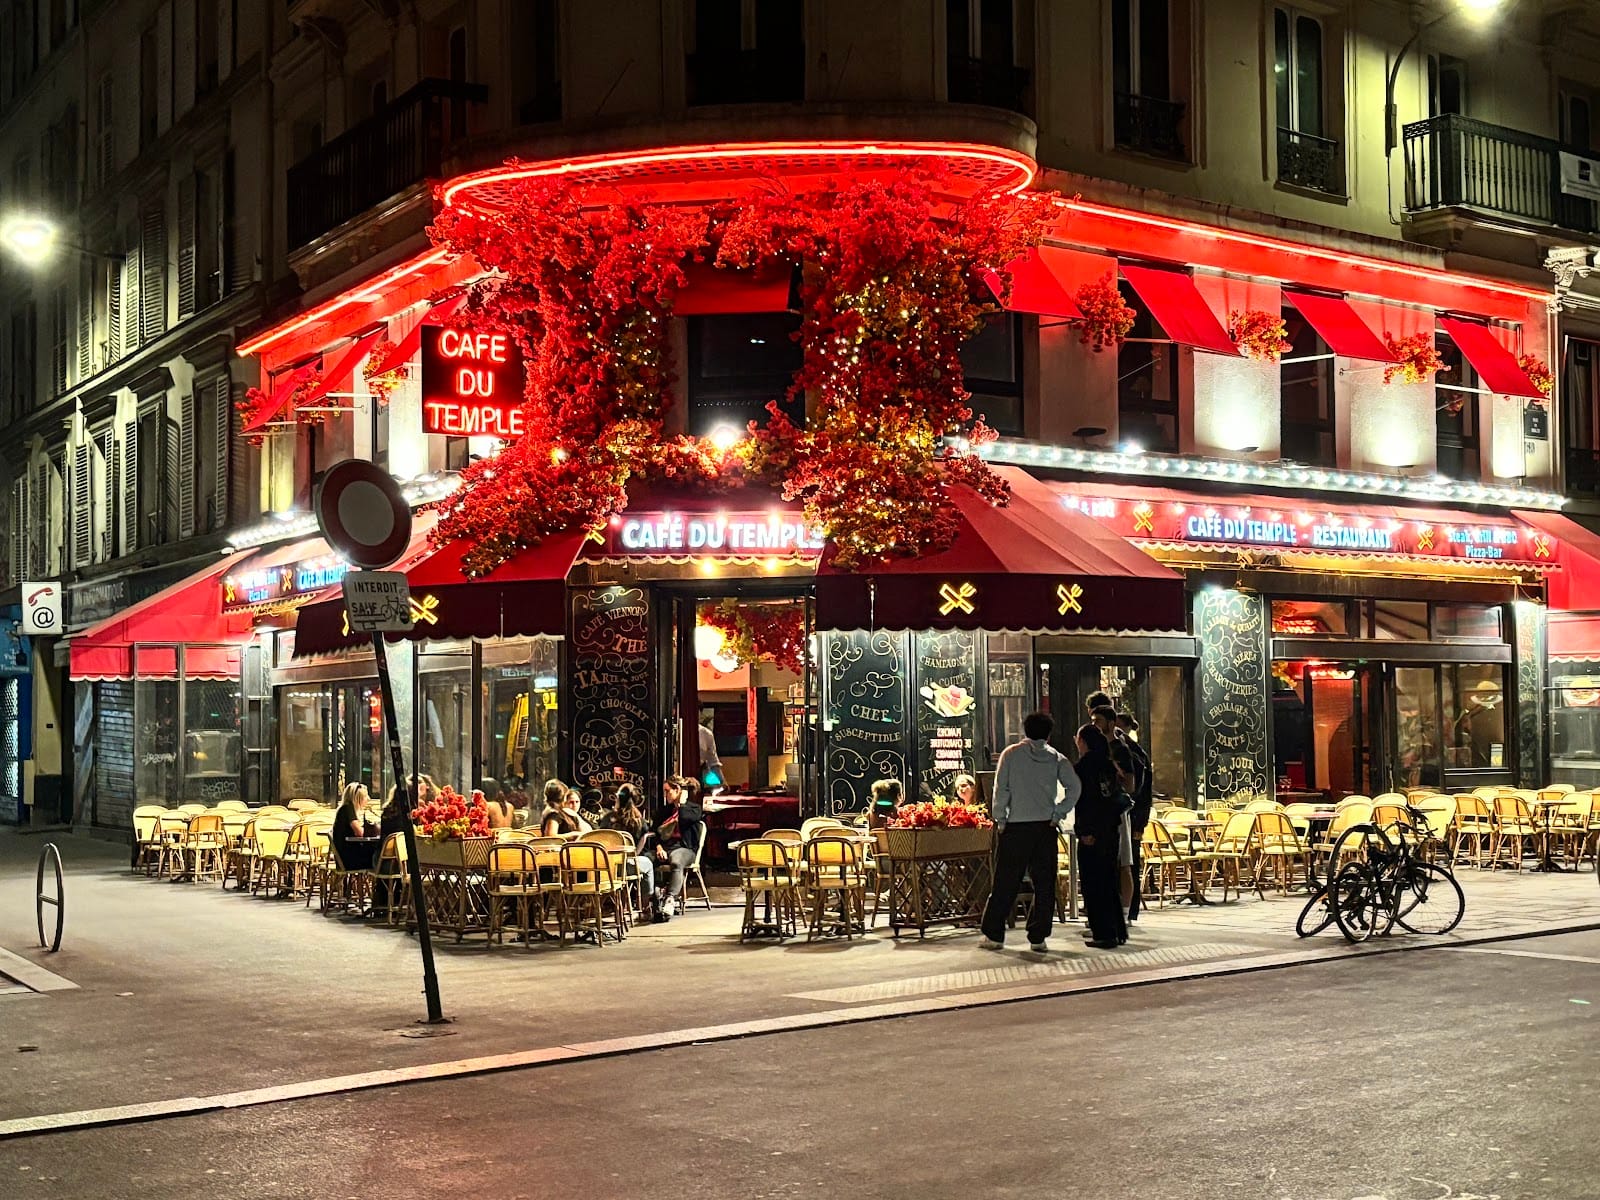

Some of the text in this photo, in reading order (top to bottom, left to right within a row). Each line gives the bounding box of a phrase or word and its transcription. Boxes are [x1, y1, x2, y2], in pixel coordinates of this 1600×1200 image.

[440, 330, 507, 363] CAFE
[458, 369, 494, 397] DU
[426, 402, 525, 435] TEMPLE
[622, 517, 683, 548] CAFÉ
[689, 521, 725, 548] DU
[1187, 513, 1222, 538] CAFÉ
[1224, 517, 1245, 540] DU
[1246, 519, 1298, 544] TEMPLE
[1311, 525, 1393, 549] RESTAURANT
[1465, 545, 1503, 559] Pizza-Bar
[354, 582, 398, 593] INTERDIT
[612, 634, 648, 653] THÉ
[600, 699, 650, 722] CHOCOLAT
[580, 730, 628, 750] GLACES
